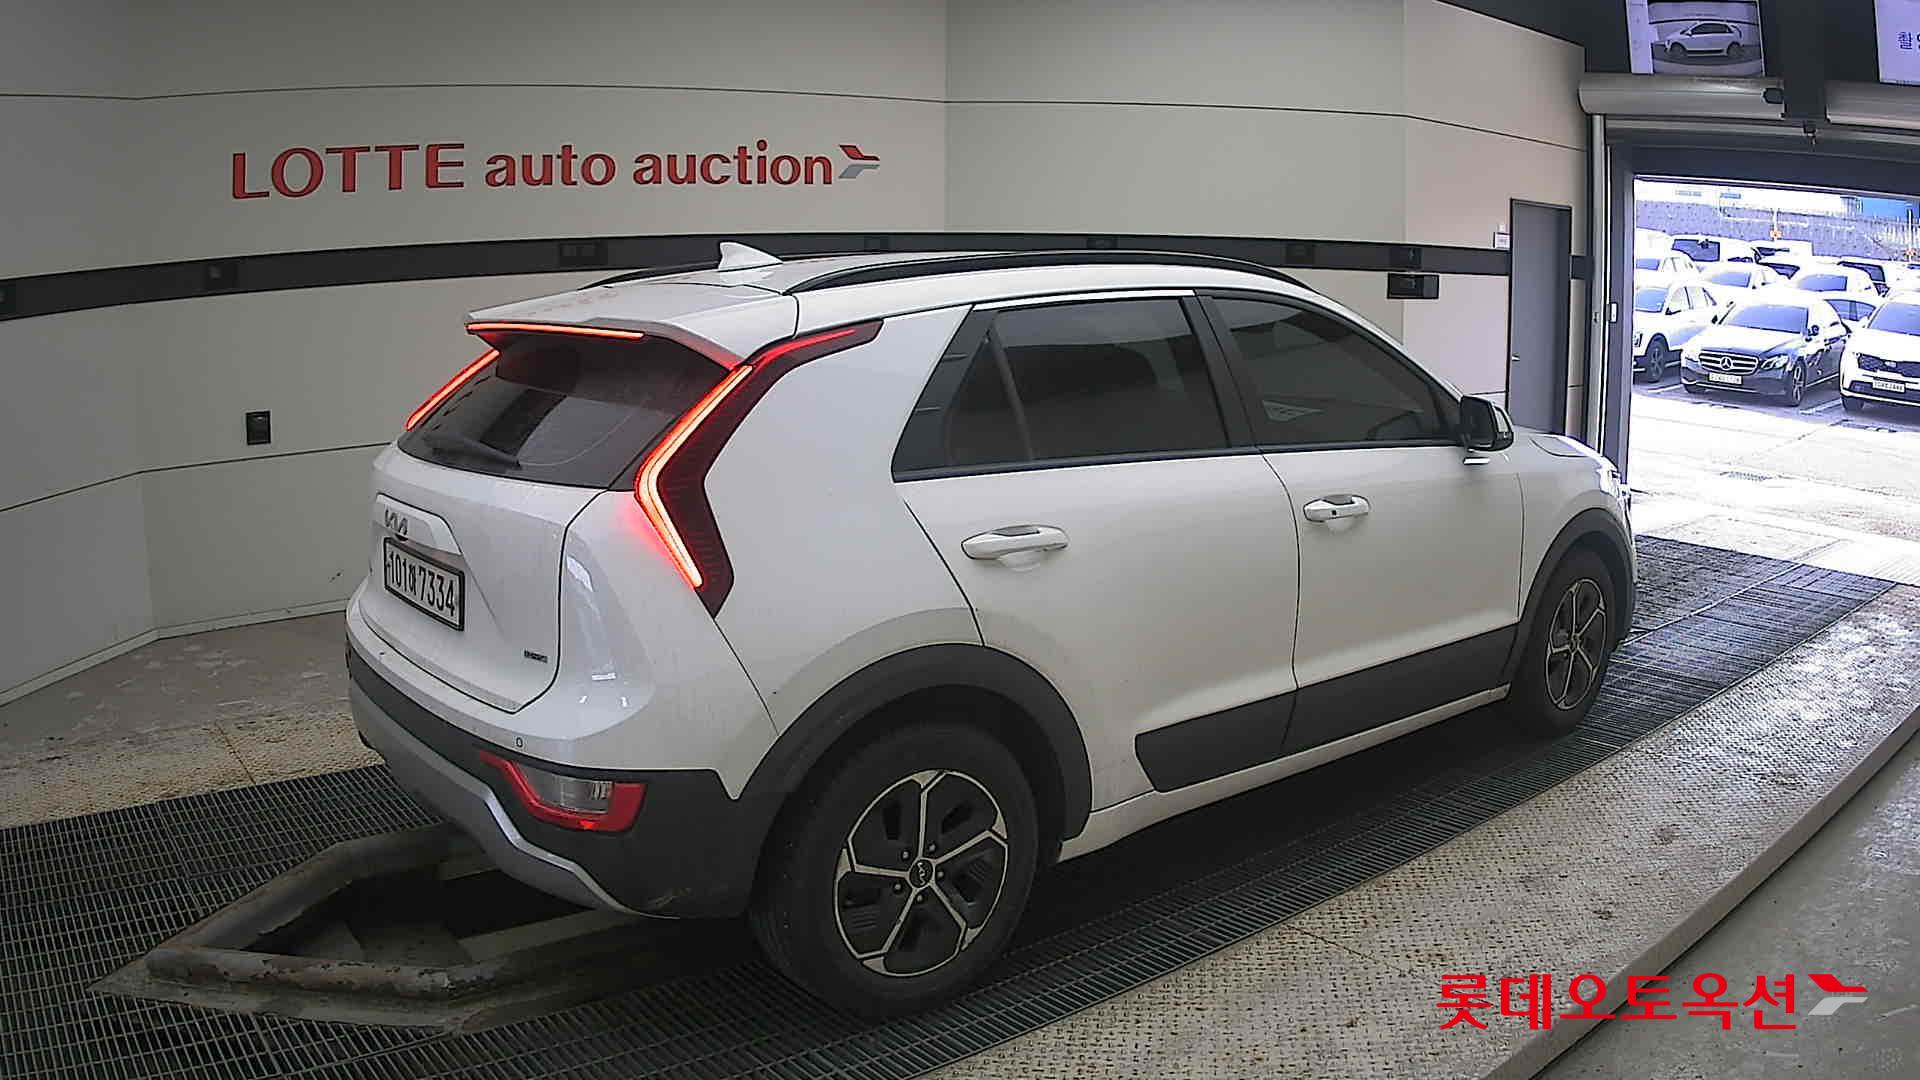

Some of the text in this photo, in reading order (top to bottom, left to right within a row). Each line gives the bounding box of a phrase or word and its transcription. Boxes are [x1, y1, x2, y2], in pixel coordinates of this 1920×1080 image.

[232, 139, 833, 199] LOTTE auto auction
